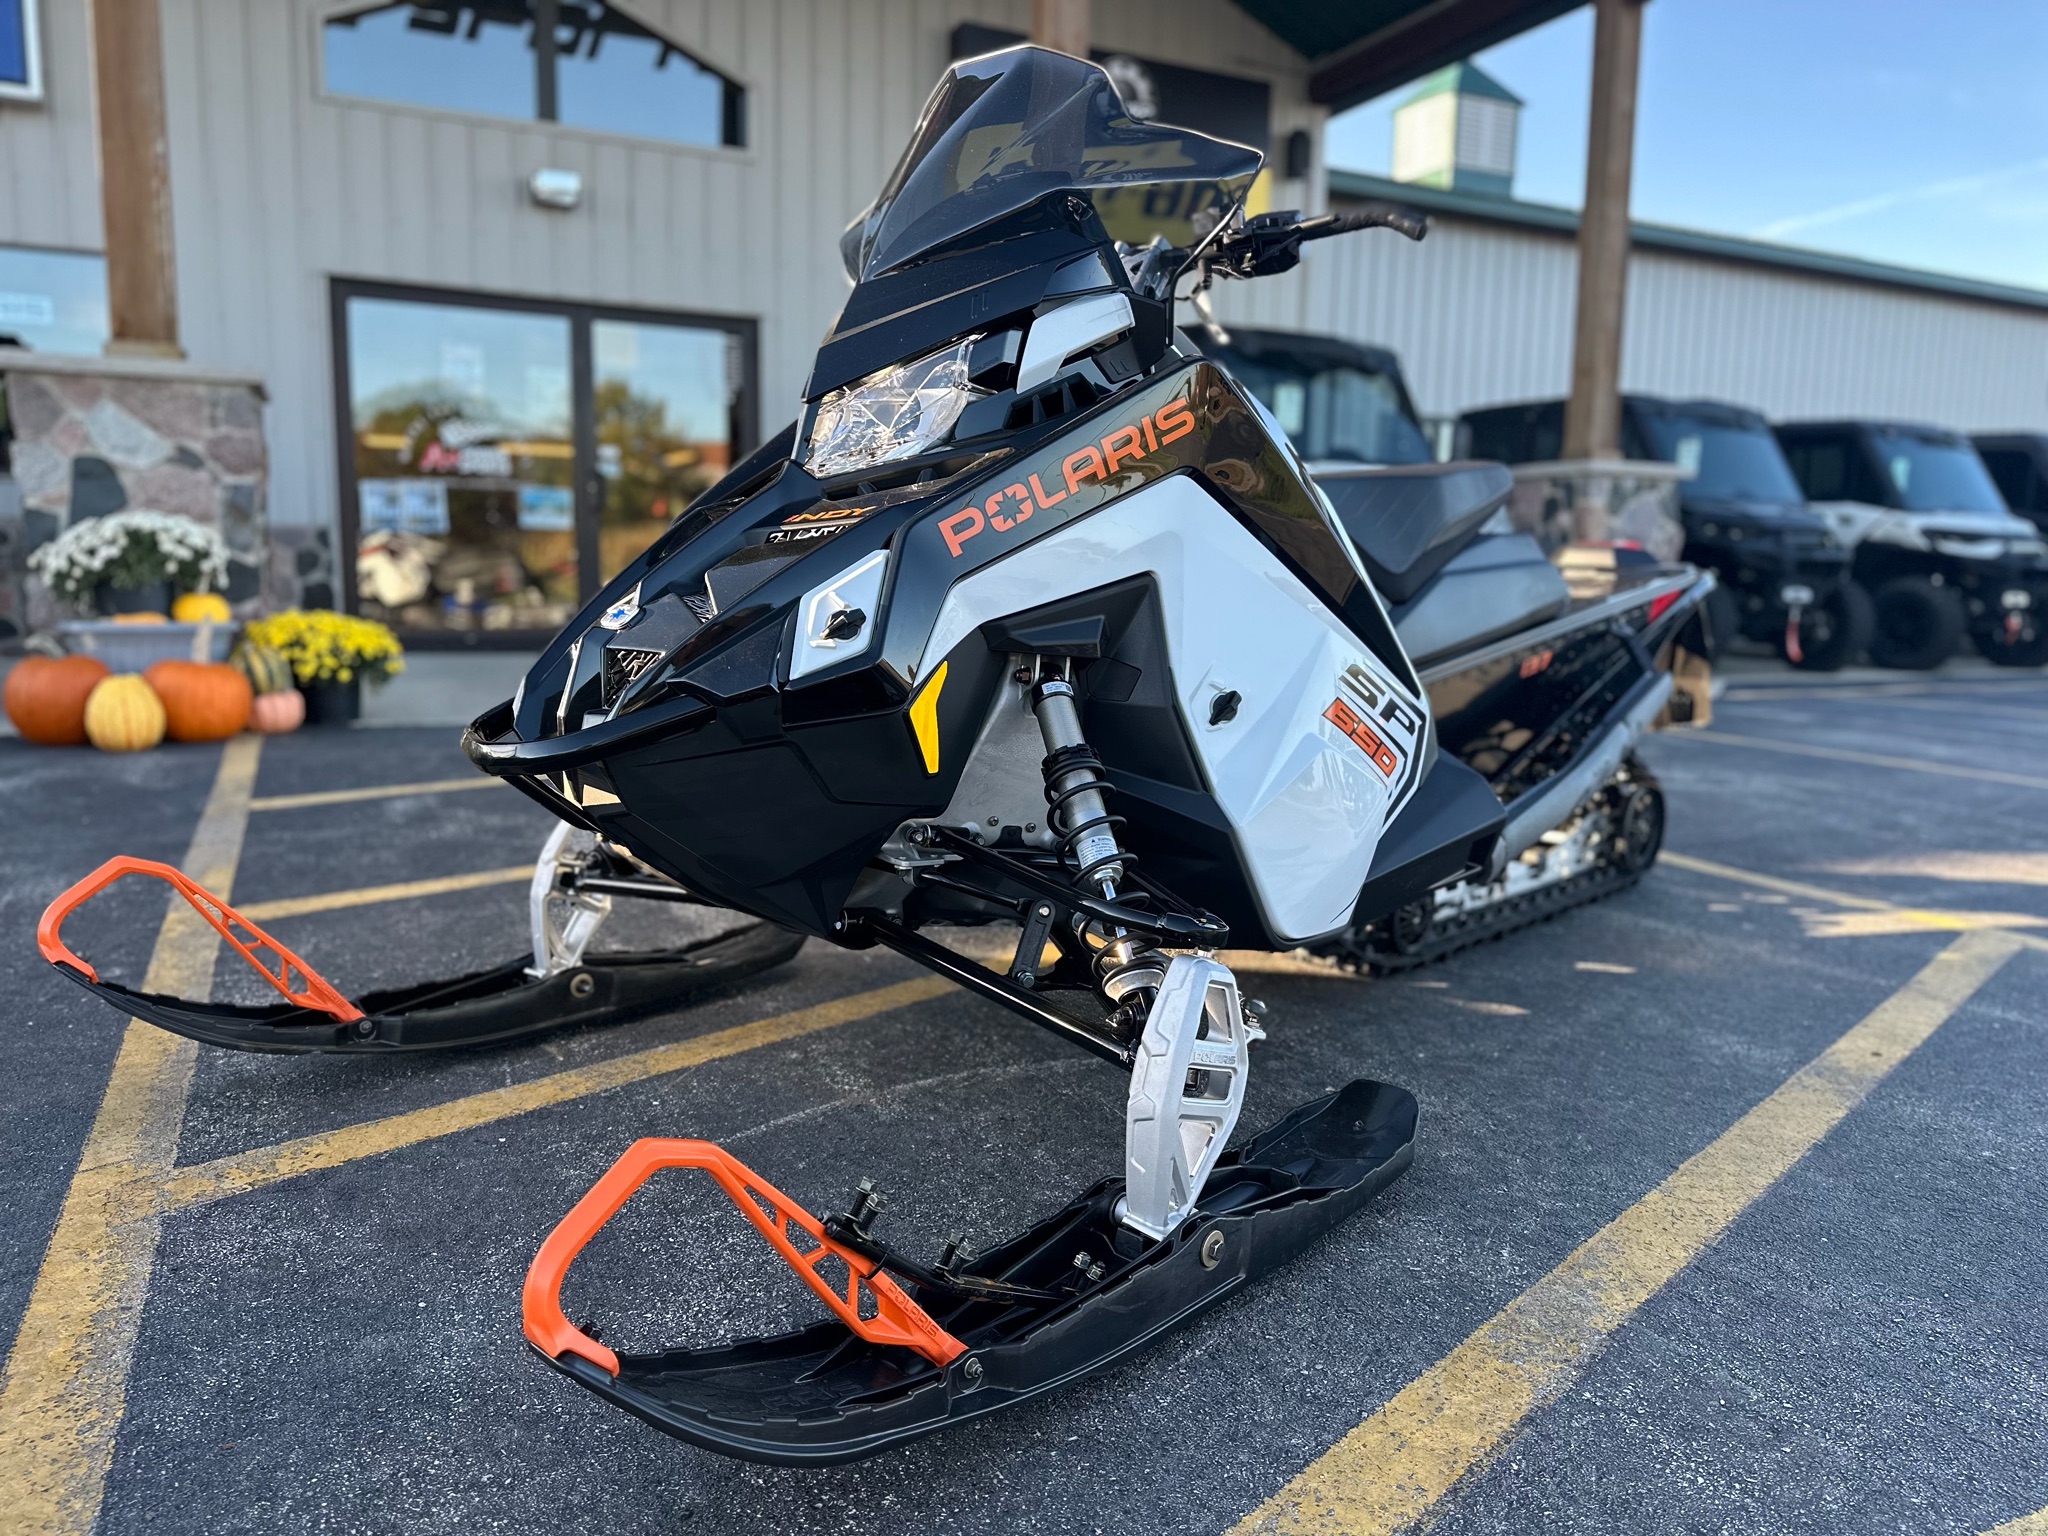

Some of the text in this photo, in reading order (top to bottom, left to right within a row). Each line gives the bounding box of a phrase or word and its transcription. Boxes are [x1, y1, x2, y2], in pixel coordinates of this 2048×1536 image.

[937, 397, 1195, 558] POLARIS
[781, 505, 877, 523] INDY
[1338, 663, 1416, 737] SP
[1322, 697, 1398, 778] 650
[1193, 1051, 1237, 1065] POLARIS
[886, 1281, 940, 1338] POLARIS
